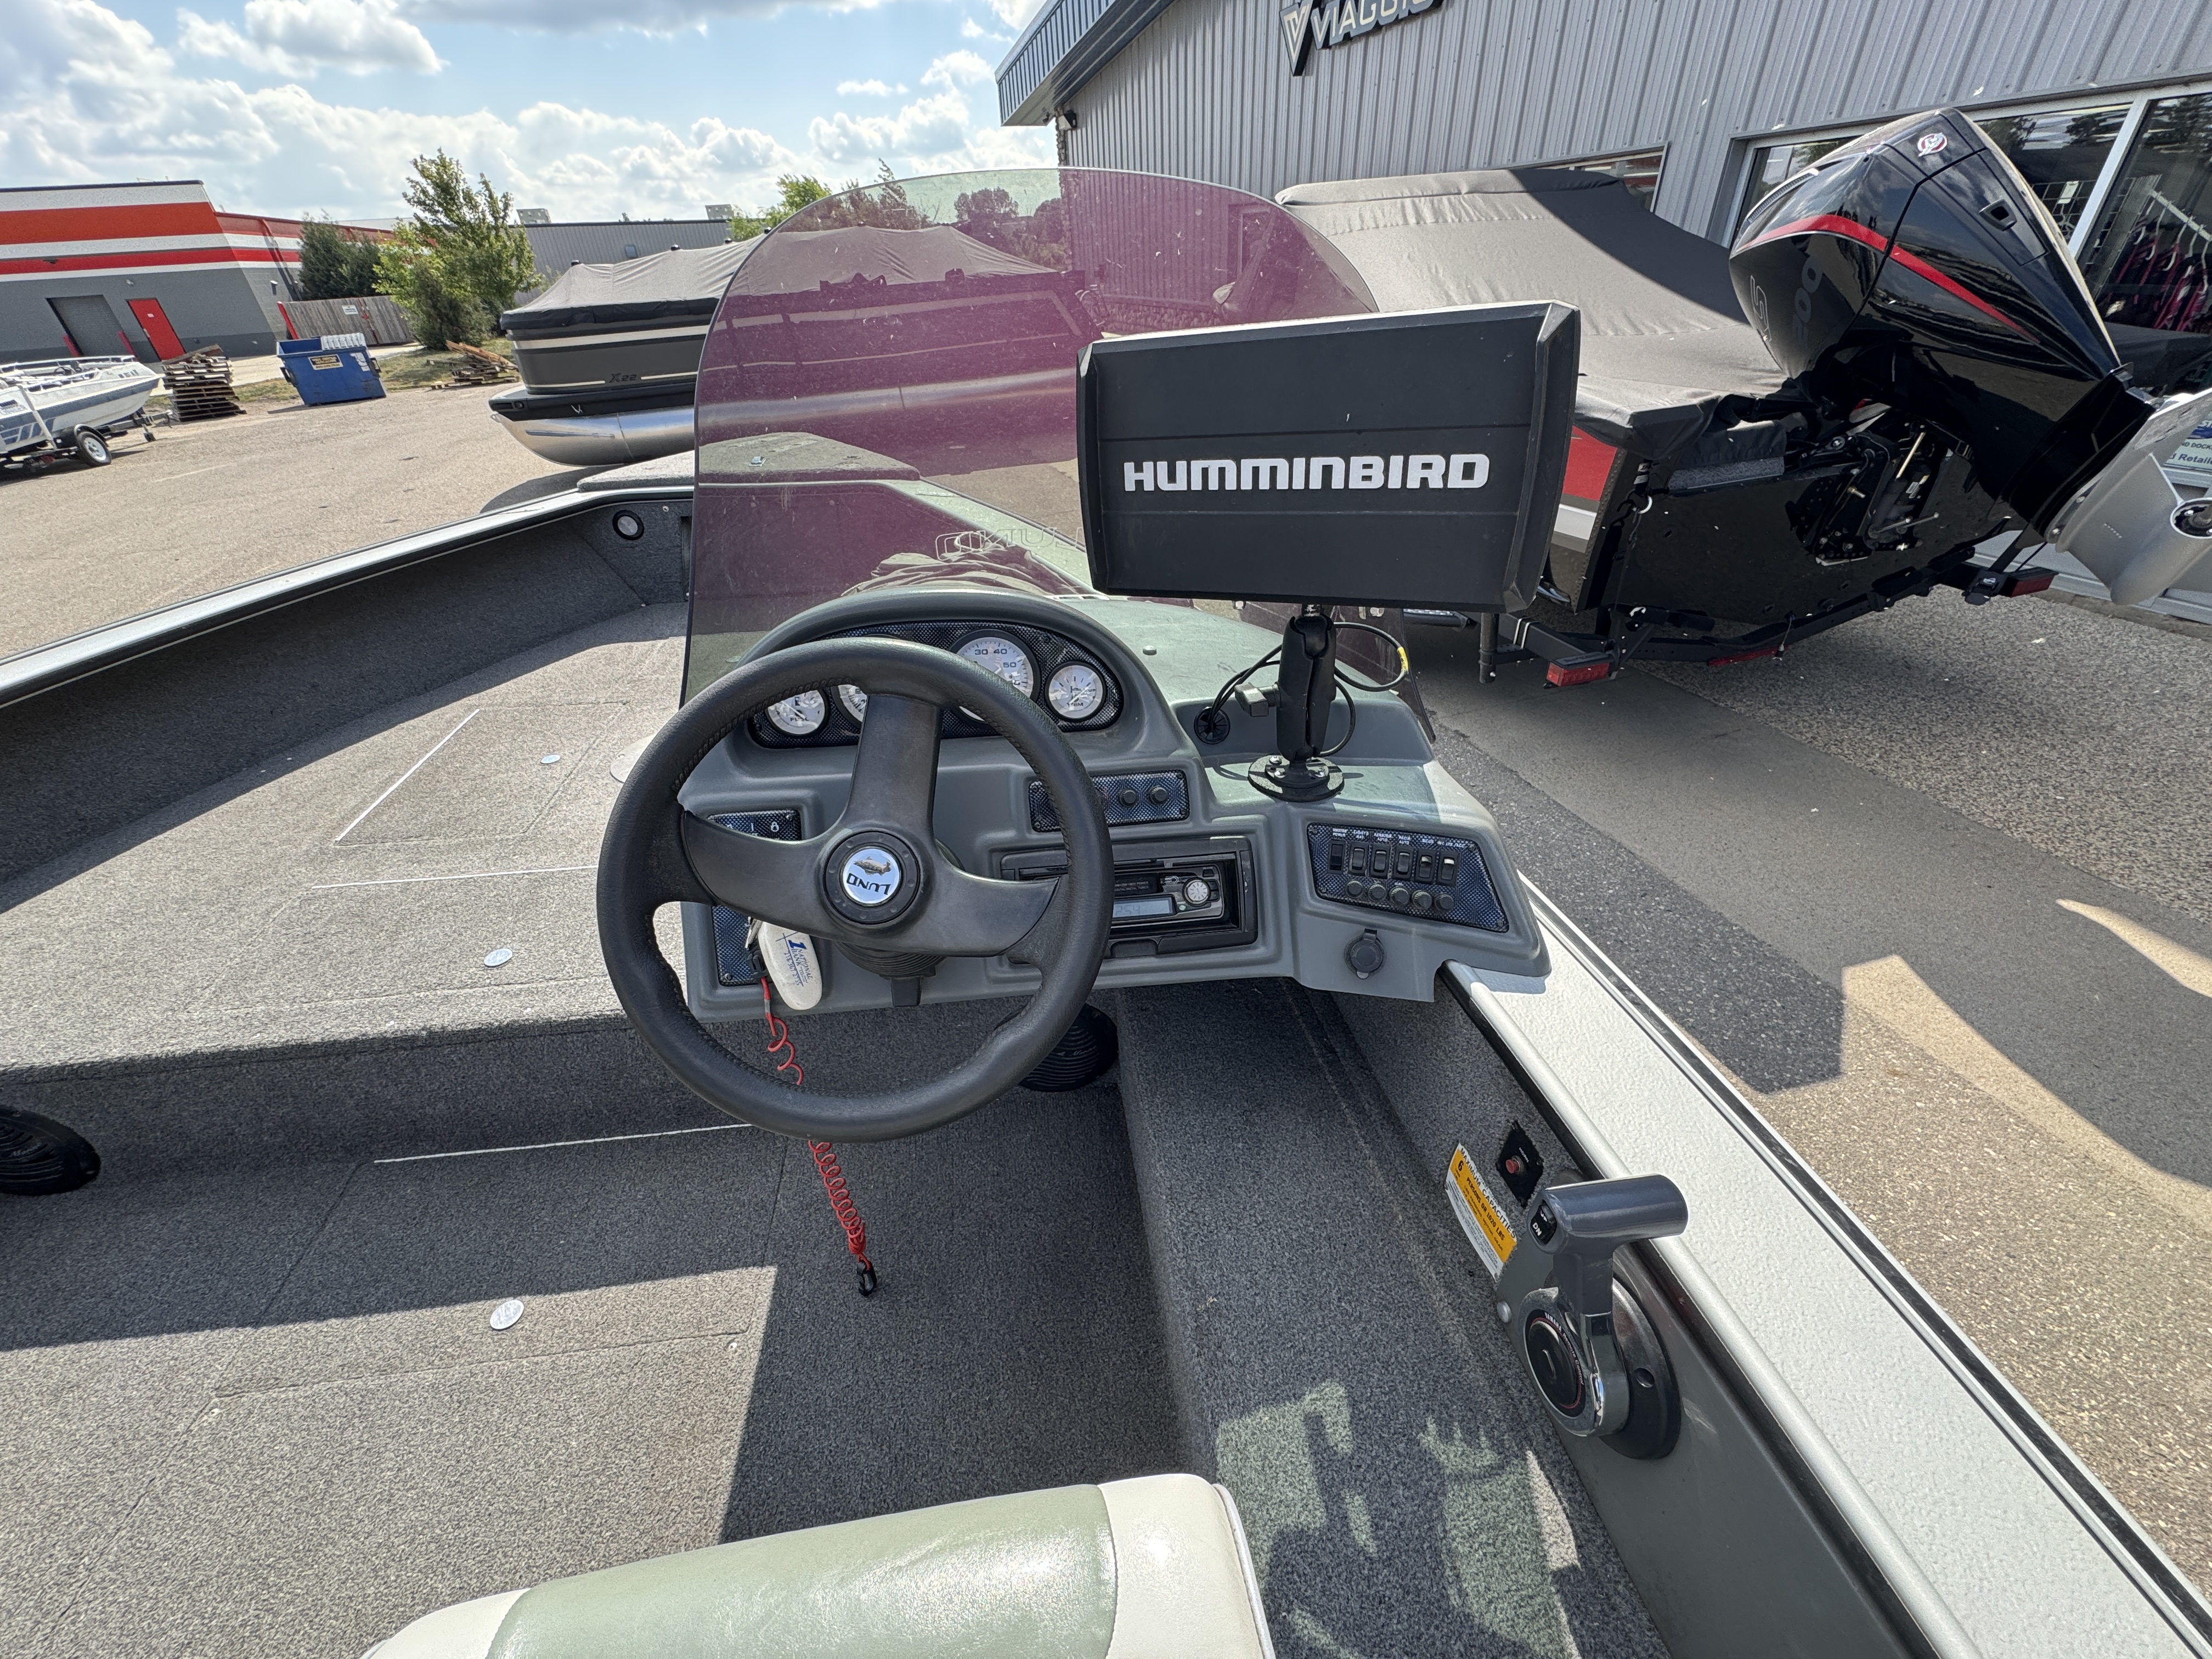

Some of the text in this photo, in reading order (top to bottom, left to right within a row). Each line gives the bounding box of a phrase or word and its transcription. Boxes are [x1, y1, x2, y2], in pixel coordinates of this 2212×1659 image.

[1313, 0, 1428, 43] VIAGG
[1123, 453, 1491, 492] HUMMINBIRD
[847, 872, 891, 895] LUND
[791, 949, 802, 967] BANK
[798, 949, 813, 980] NATIONAL
[1458, 1160, 1464, 1172] 6
[1519, 1147, 1530, 1163] HORN
[1460, 1147, 1481, 1188] MAXIMUM
[1482, 1188, 1516, 1239] CAPACITIES
[1466, 1177, 1505, 1241] PERSONS OR 1020 LBS
[1532, 1222, 1542, 1236] DN
[1544, 1312, 1562, 1333] YAMAHA
